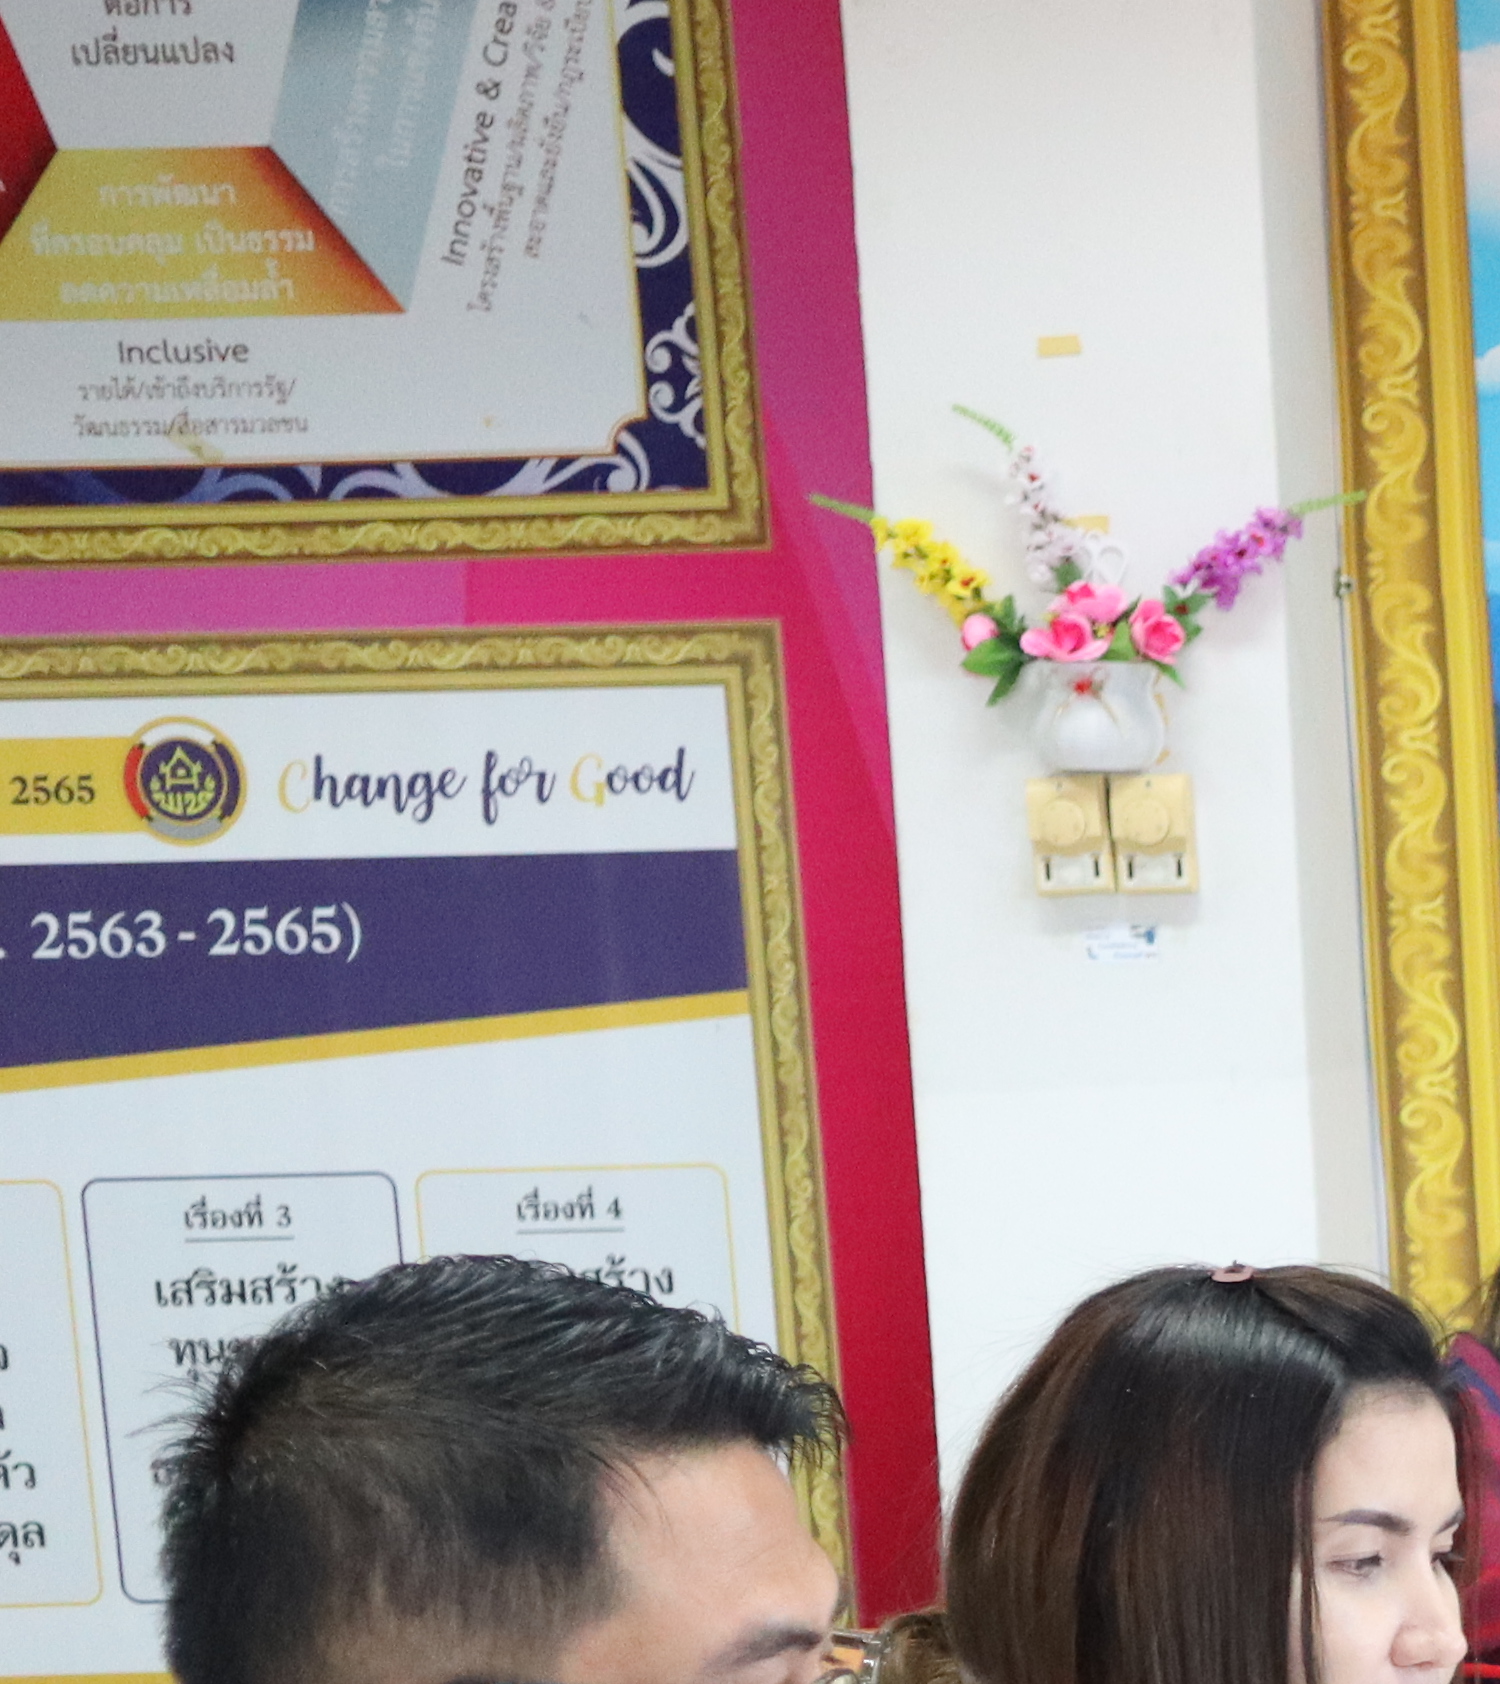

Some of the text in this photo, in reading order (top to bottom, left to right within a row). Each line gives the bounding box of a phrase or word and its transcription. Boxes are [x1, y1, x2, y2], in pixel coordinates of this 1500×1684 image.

[71, 28, 235, 66] เปลี่ยนแปลง
[100, 172, 237, 207] การพัฒนา
[441, 110, 495, 266] Innovative
[476, 77, 502, 101] &
[117, 339, 250, 364] Inclusive
[11, 776, 95, 806] 2565
[277, 746, 696, 826] Change for Good
[183, 1195, 292, 1230] เรื่องที่ 3
[516, 1184, 622, 1221] เรื่องที่ 4
